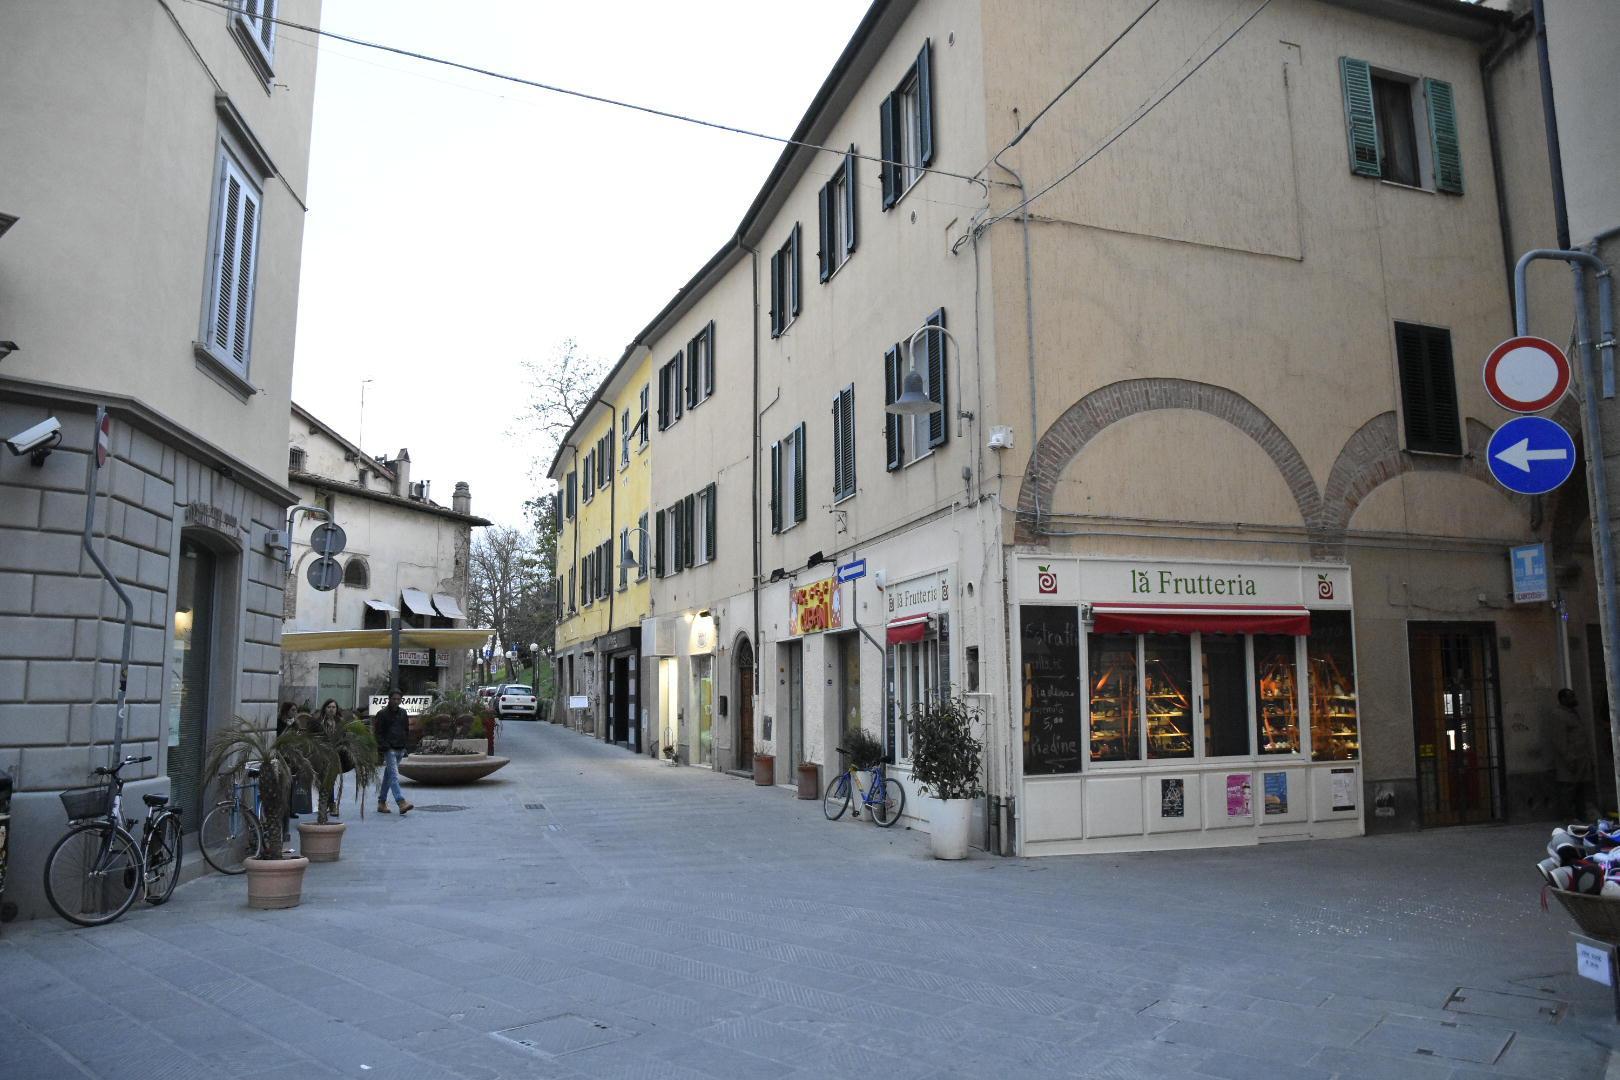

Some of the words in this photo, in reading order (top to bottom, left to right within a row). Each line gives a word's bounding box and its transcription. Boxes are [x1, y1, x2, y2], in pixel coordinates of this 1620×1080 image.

[1517, 549, 1538, 576] T
[1158, 571, 1258, 596] Frutteria
[905, 586, 937, 607] Frutteria
[372, 697, 430, 705] RISRANTE
